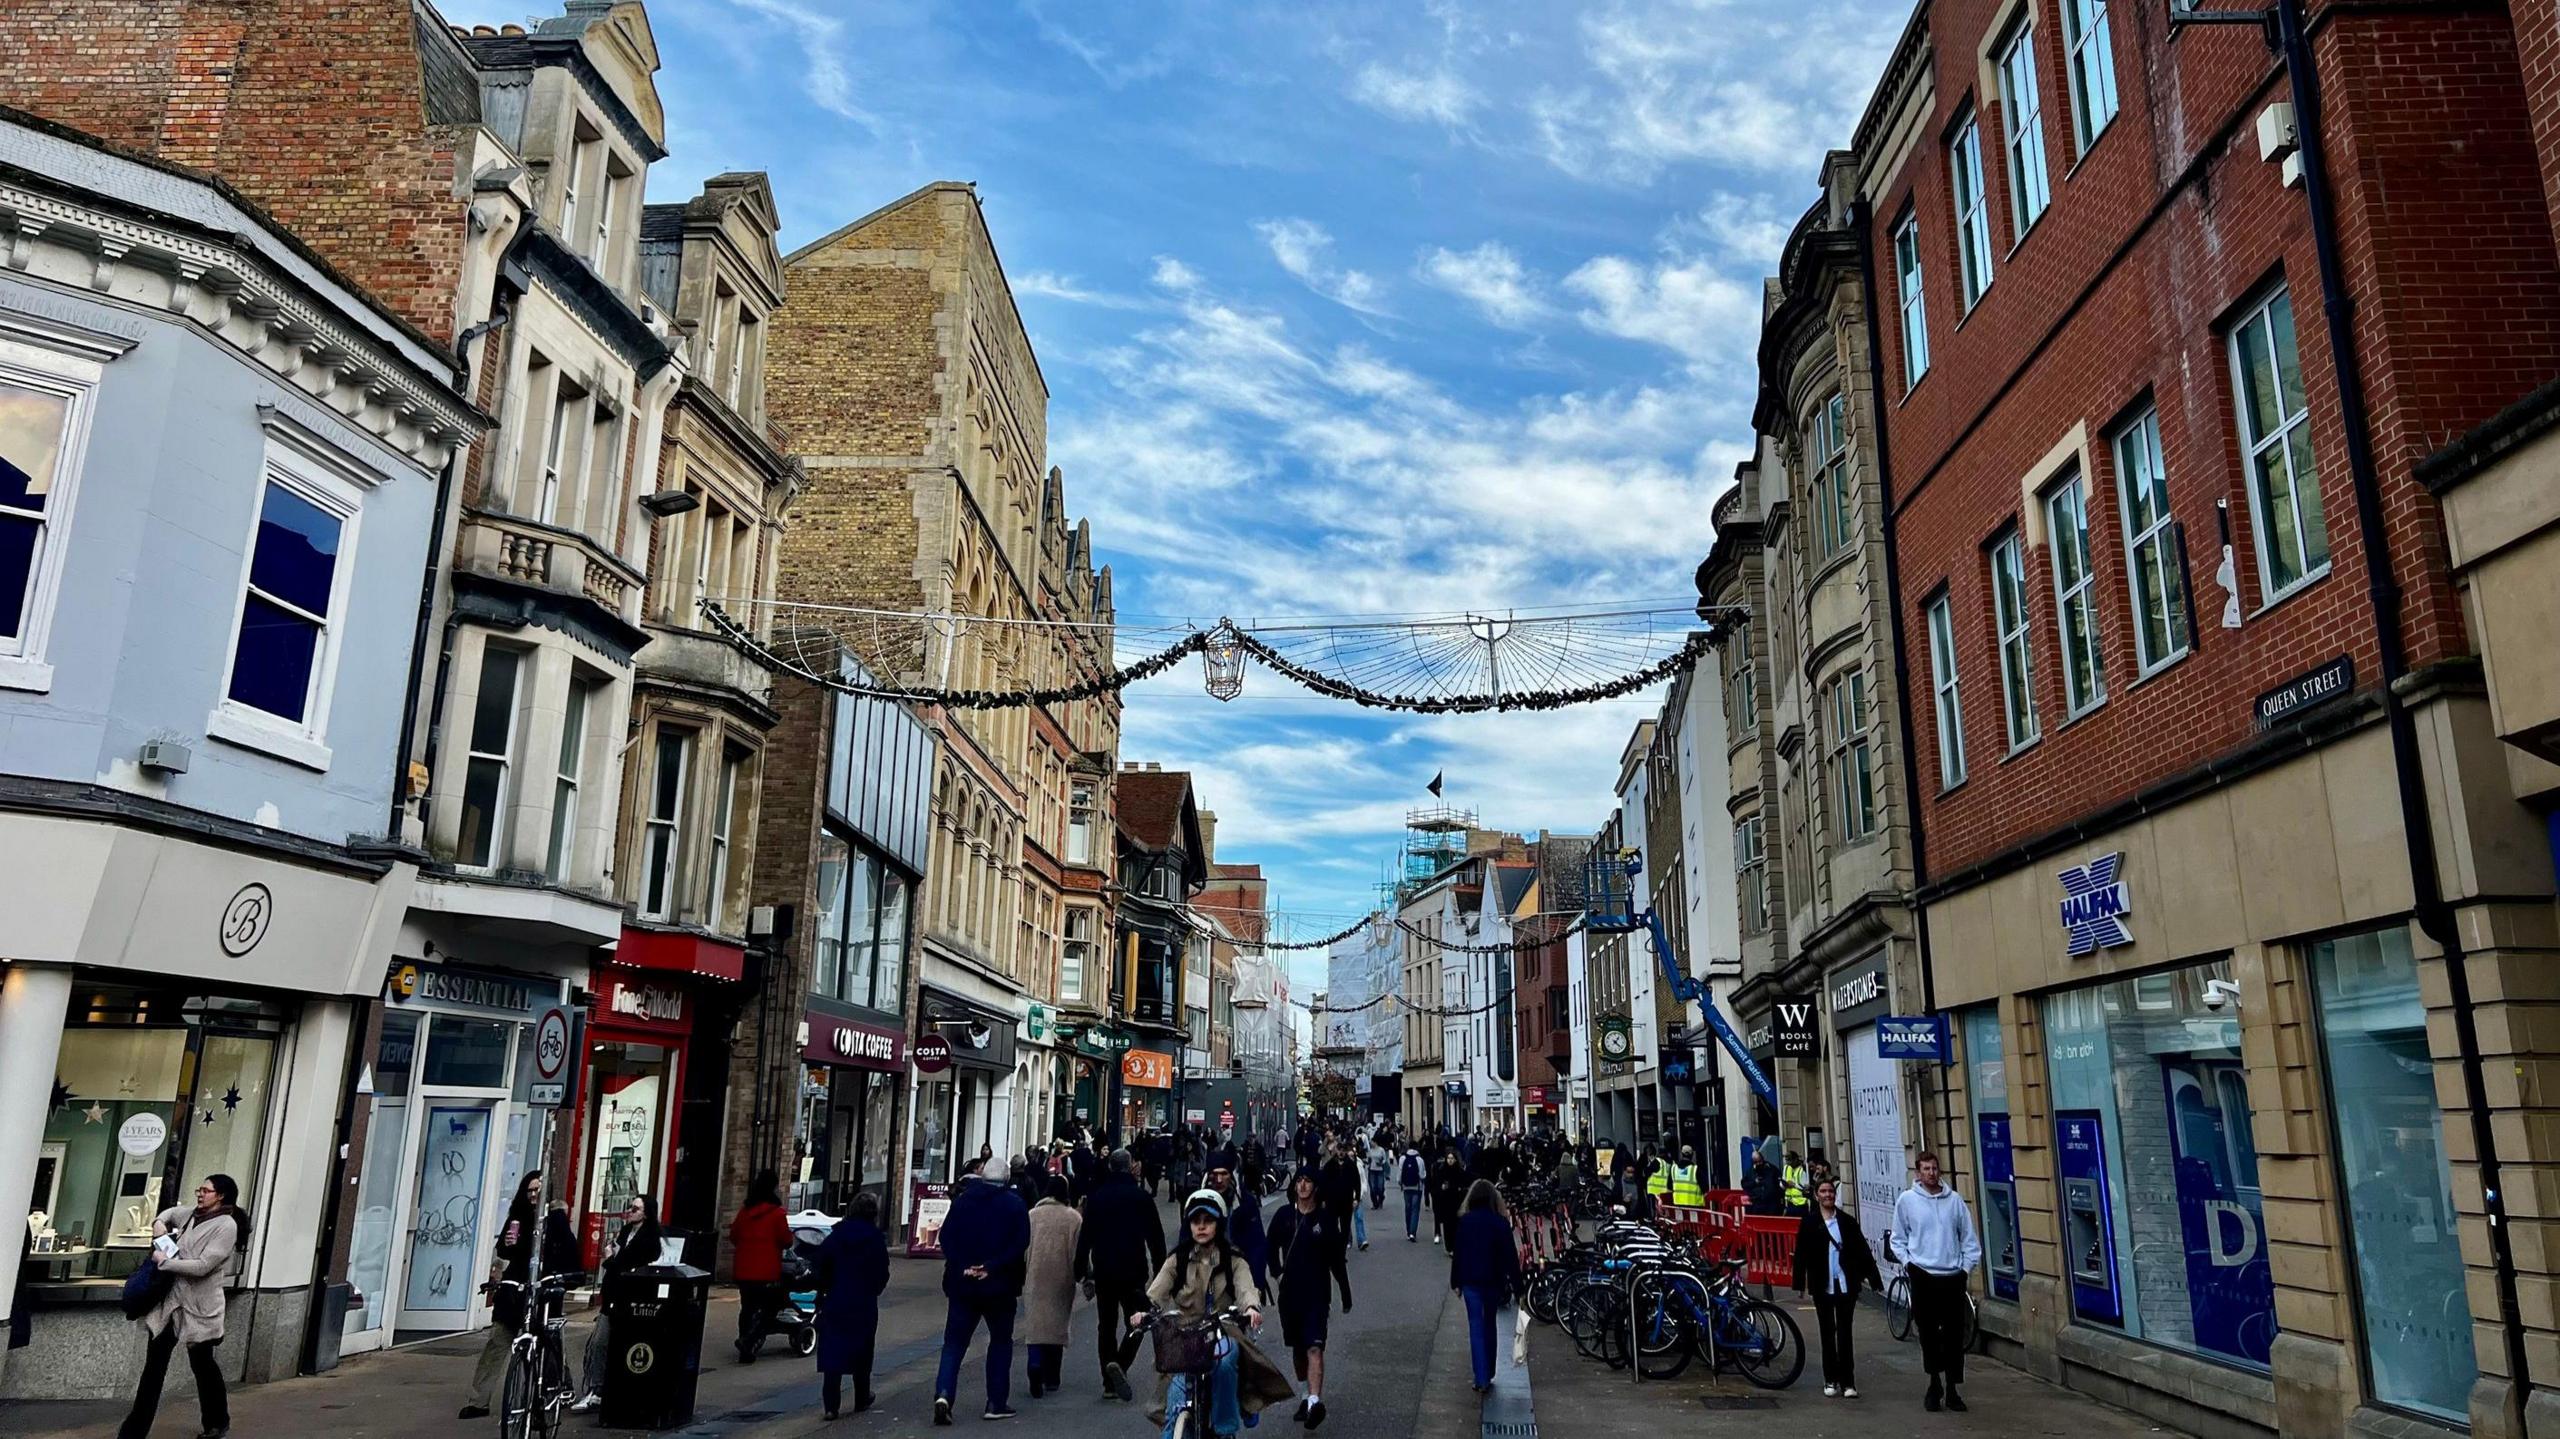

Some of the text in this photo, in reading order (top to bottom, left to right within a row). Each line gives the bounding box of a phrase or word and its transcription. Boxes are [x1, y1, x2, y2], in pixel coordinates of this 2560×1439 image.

[2263, 666, 2342, 717] QUEEN STREET
[2060, 884, 2123, 928] HALIFAX
[420, 972, 533, 1011] ESSENTIAL
[650, 989, 682, 1020] World
[1831, 971, 1877, 1012] WATERSTONES
[1777, 1004, 1811, 1028] W
[840, 1028, 893, 1060] COSTA COFFEE
[1780, 1032, 1813, 1040] BOOKS
[1785, 1041, 1809, 1050] CAFÉ
[1881, 1033, 1936, 1043] HALIFAX
[916, 1047, 947, 1056] COSTA
[1726, 1033, 1771, 1093] Summit Platforms
[131, 1126, 162, 1135] YEARS
[1874, 1149, 1890, 1176] NEW
